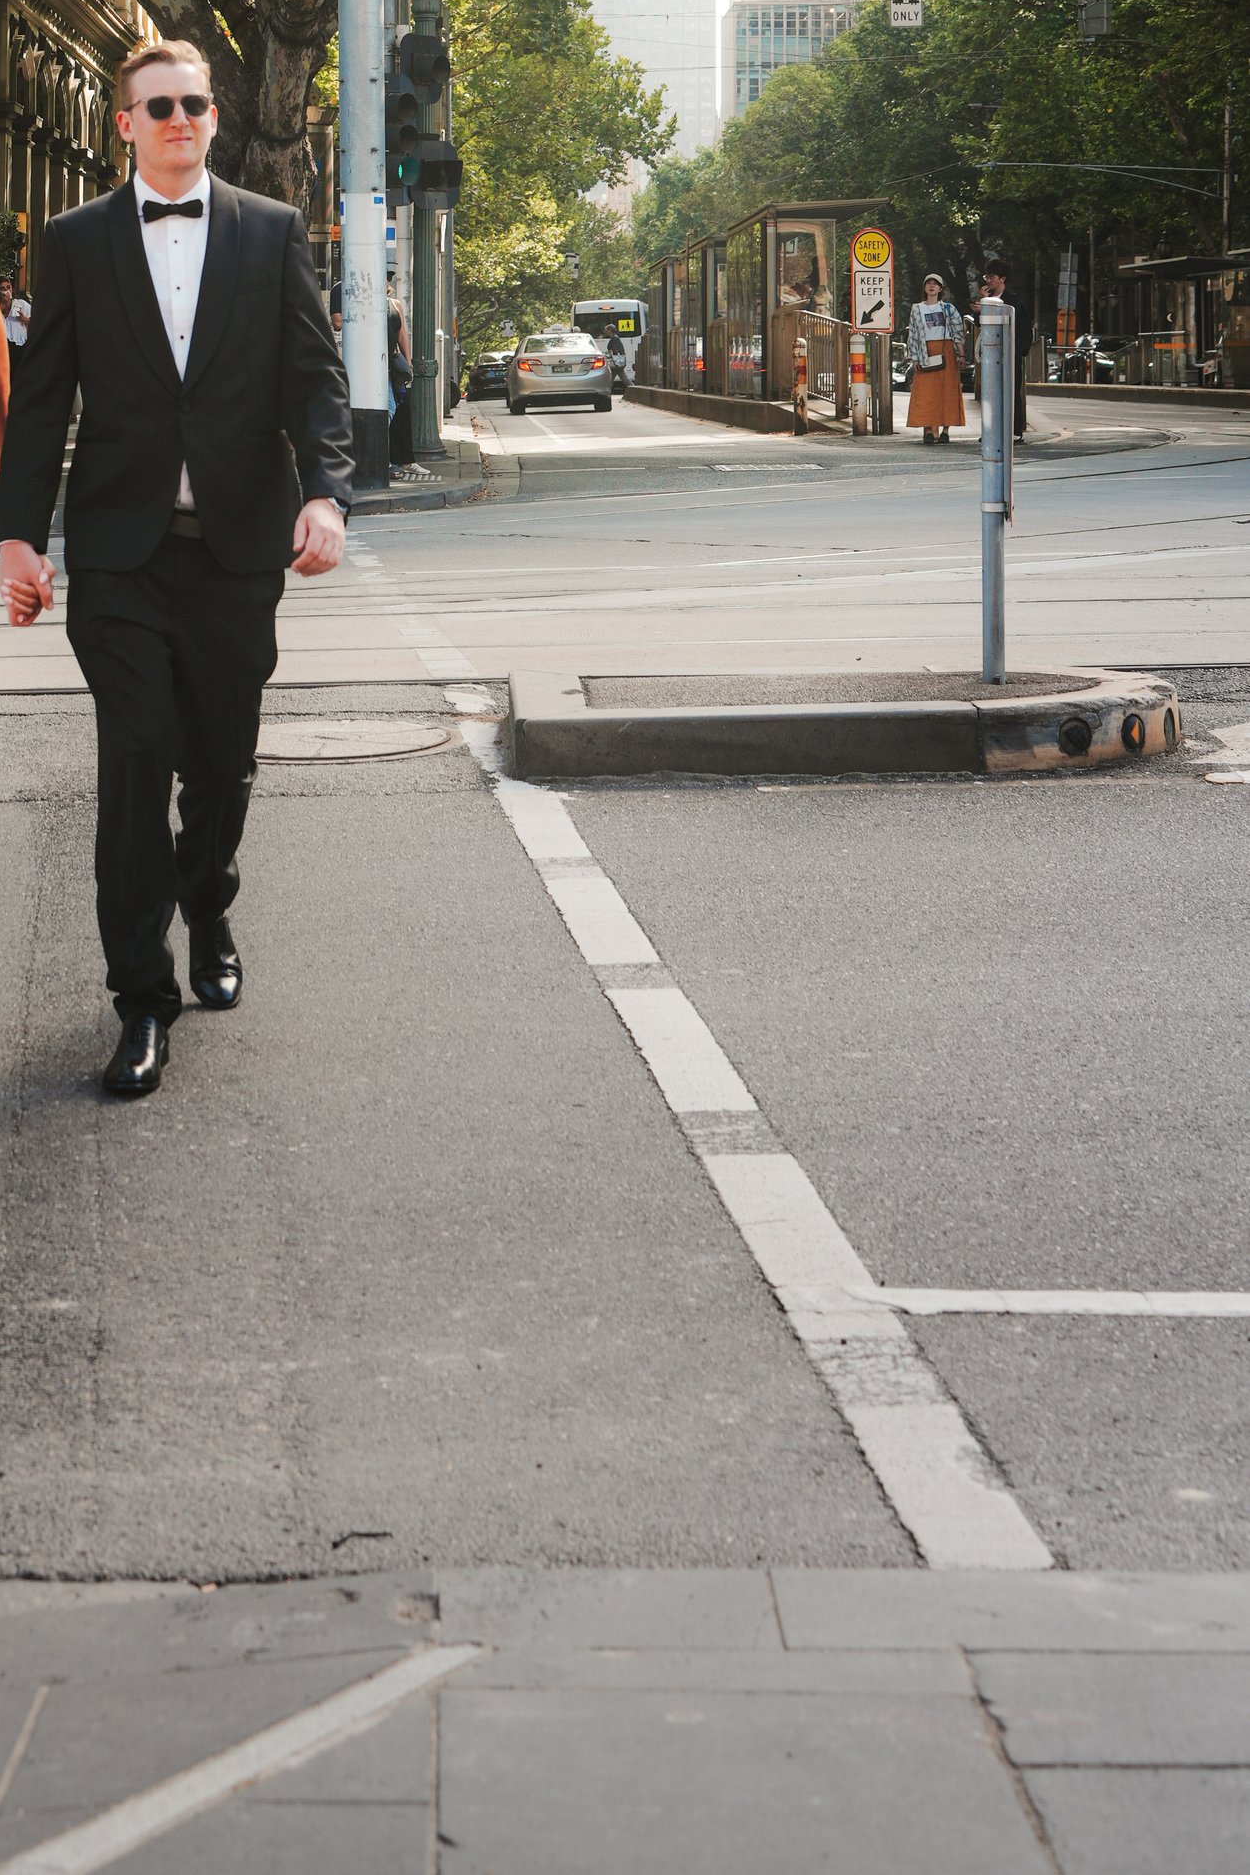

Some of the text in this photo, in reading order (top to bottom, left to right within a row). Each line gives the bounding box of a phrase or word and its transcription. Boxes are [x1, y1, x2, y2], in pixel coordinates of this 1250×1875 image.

[893, 11, 919, 21] ONLY
[858, 240, 886, 250] SAFETY
[862, 252, 881, 262] ZONE
[860, 276, 885, 286] KEEP
[861, 287, 884, 296] LEFT
